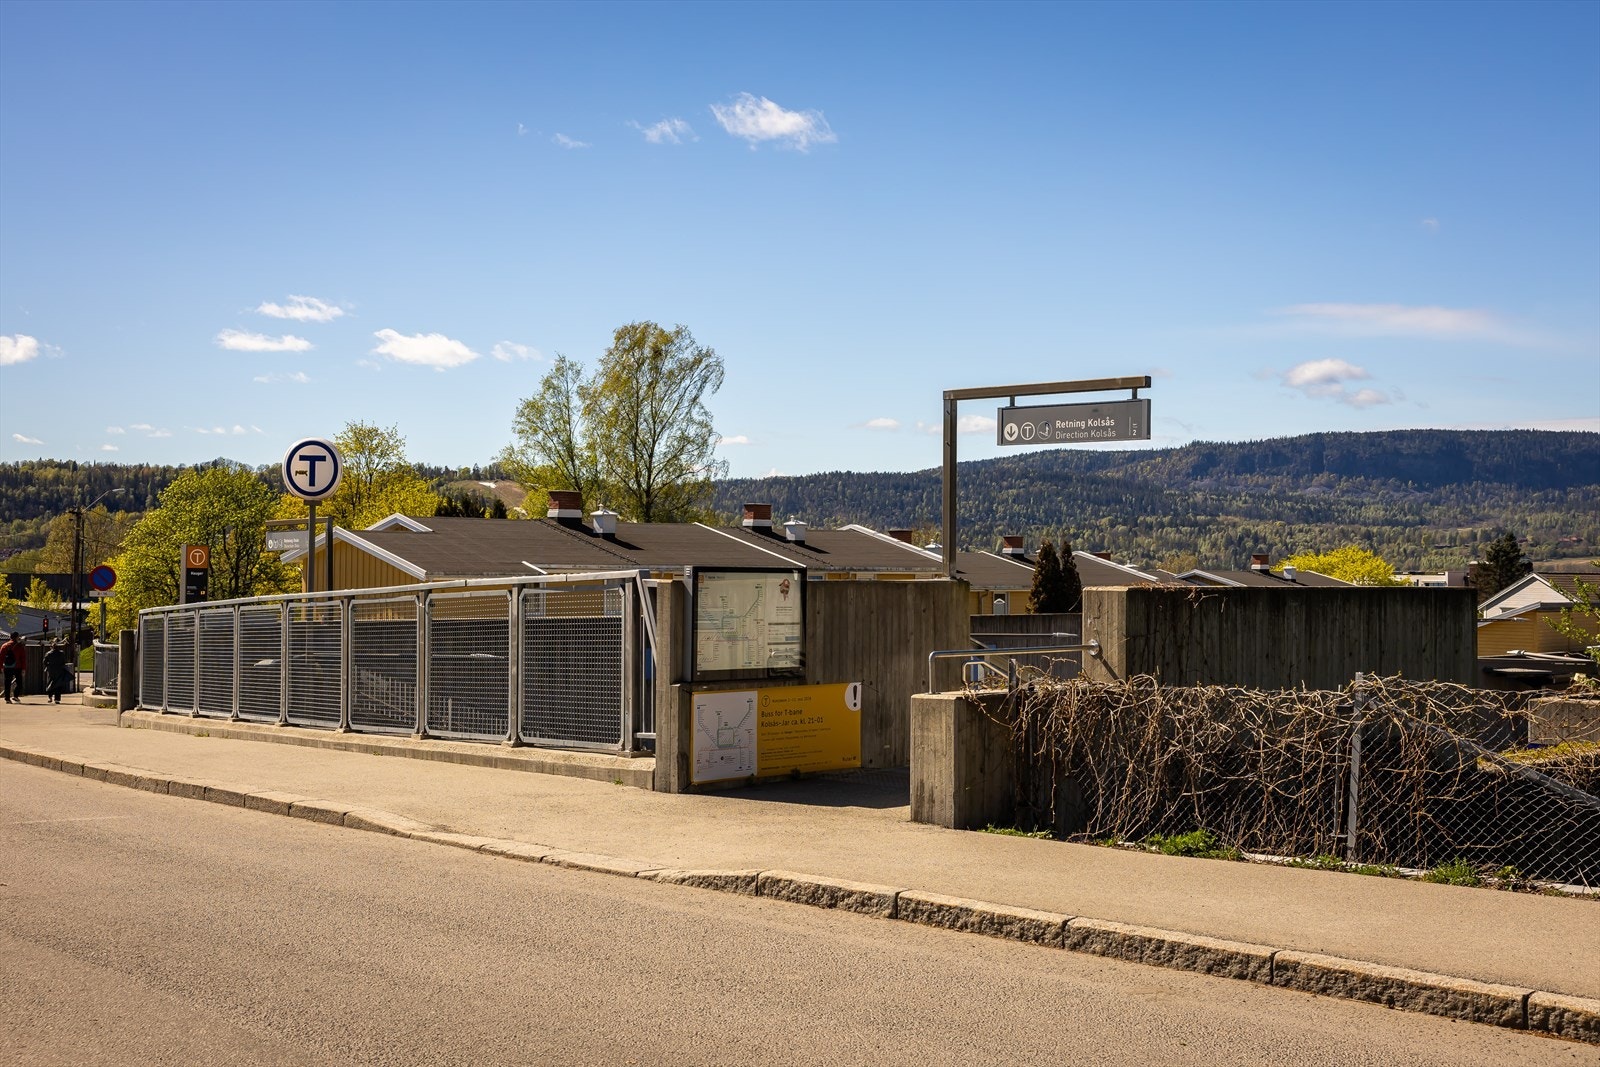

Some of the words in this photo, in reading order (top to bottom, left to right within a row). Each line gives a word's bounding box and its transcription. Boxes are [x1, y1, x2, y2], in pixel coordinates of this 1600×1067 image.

[1055, 419, 1085, 430] Retning
[1087, 416, 1115, 427] Kolsås
[1055, 430, 1089, 440] Direction
[1090, 428, 1117, 438] Kolsås
[298, 454, 327, 487] T
[761, 710, 774, 718] Buss
[784, 708, 803, 716] T-bane
